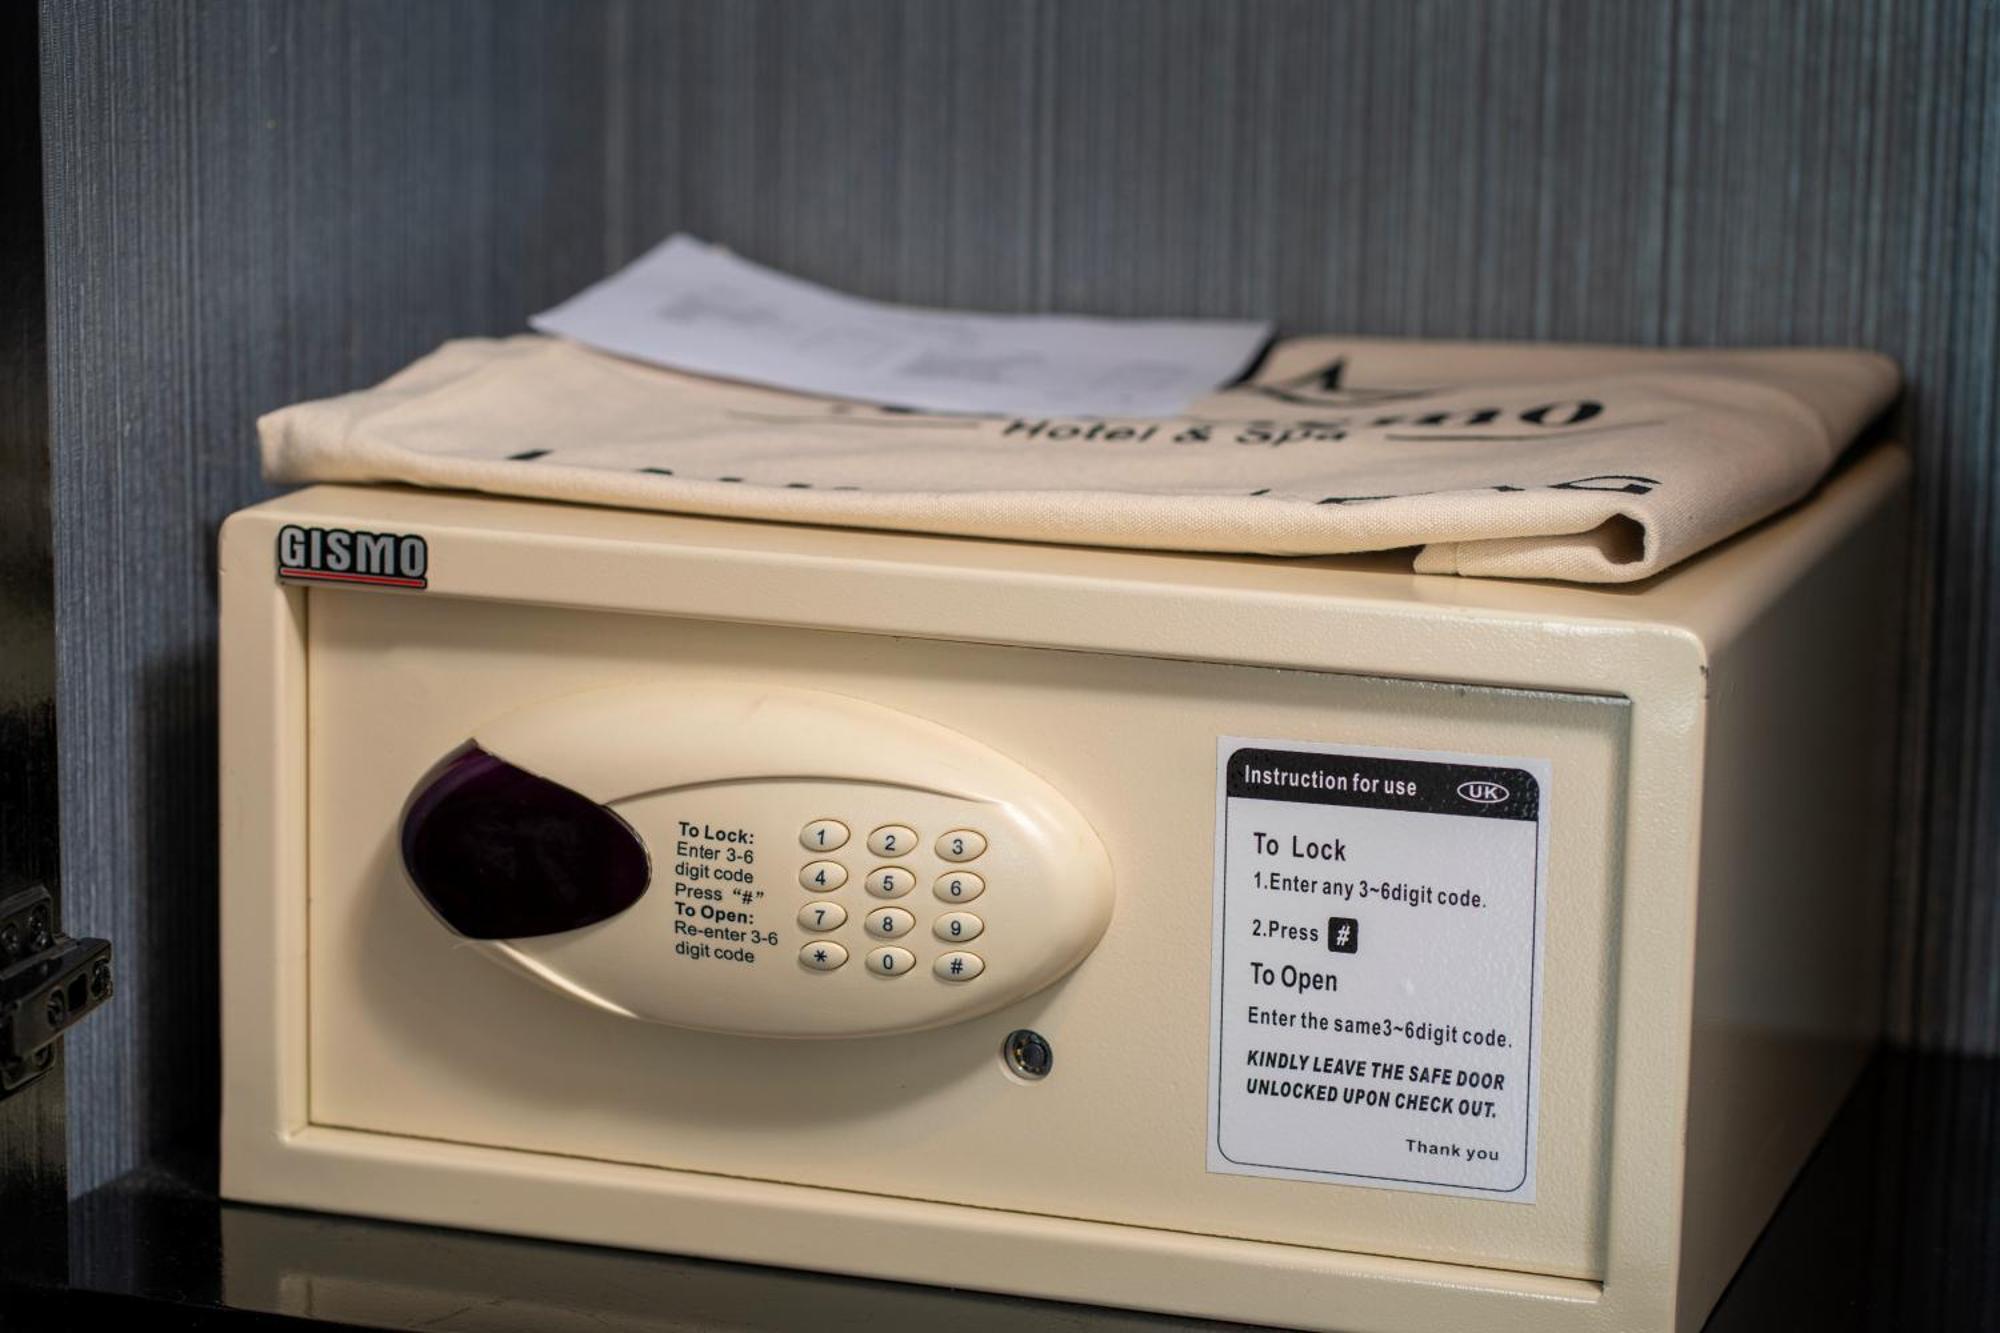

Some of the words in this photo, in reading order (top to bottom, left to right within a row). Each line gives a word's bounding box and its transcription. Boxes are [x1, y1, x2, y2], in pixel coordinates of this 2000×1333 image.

[279, 526, 427, 579] GISMO
[1244, 764, 1348, 792] Instruction
[1352, 773, 1379, 793] for
[1384, 778, 1417, 796] use
[1468, 784, 1499, 801] UK
[678, 821, 699, 838] To
[704, 825, 754, 845] Lock:
[676, 841, 721, 860] Enter
[726, 847, 754, 864] 3-6
[1253, 832, 1279, 856] To
[1292, 835, 1347, 862] Lock
[675, 862, 710, 880] digit
[714, 868, 754, 884] code
[675, 882, 723, 901] Press
[1322, 881, 1354, 901] any
[1438, 889, 1487, 908] code.
[674, 901, 696, 917] To
[701, 905, 754, 925] Open:
[674, 920, 747, 942] Re-enter
[751, 930, 778, 946] 3-6
[675, 941, 711, 960] digit
[714, 948, 754, 963] code
[1250, 962, 1275, 986] To
[1281, 965, 1338, 994] Open
[1248, 1006, 1297, 1028] Enter
[1300, 1011, 1329, 1031] the
[1462, 1029, 1512, 1048] code.
[1247, 1050, 1310, 1072] KINDLY
[1313, 1056, 1367, 1078] LEAVE
[1371, 1062, 1405, 1081] THE
[1408, 1066, 1452, 1086] SAFE
[1456, 1070, 1505, 1091] DOOR
[1246, 1078, 1338, 1102] UNLOCKED
[1343, 1088, 1390, 1108] UPON
[1395, 1093, 1454, 1114] CHECK
[1458, 1100, 1497, 1118] OUT.
[1406, 1138, 1461, 1158] Thank
[1466, 1148, 1499, 1162] you
